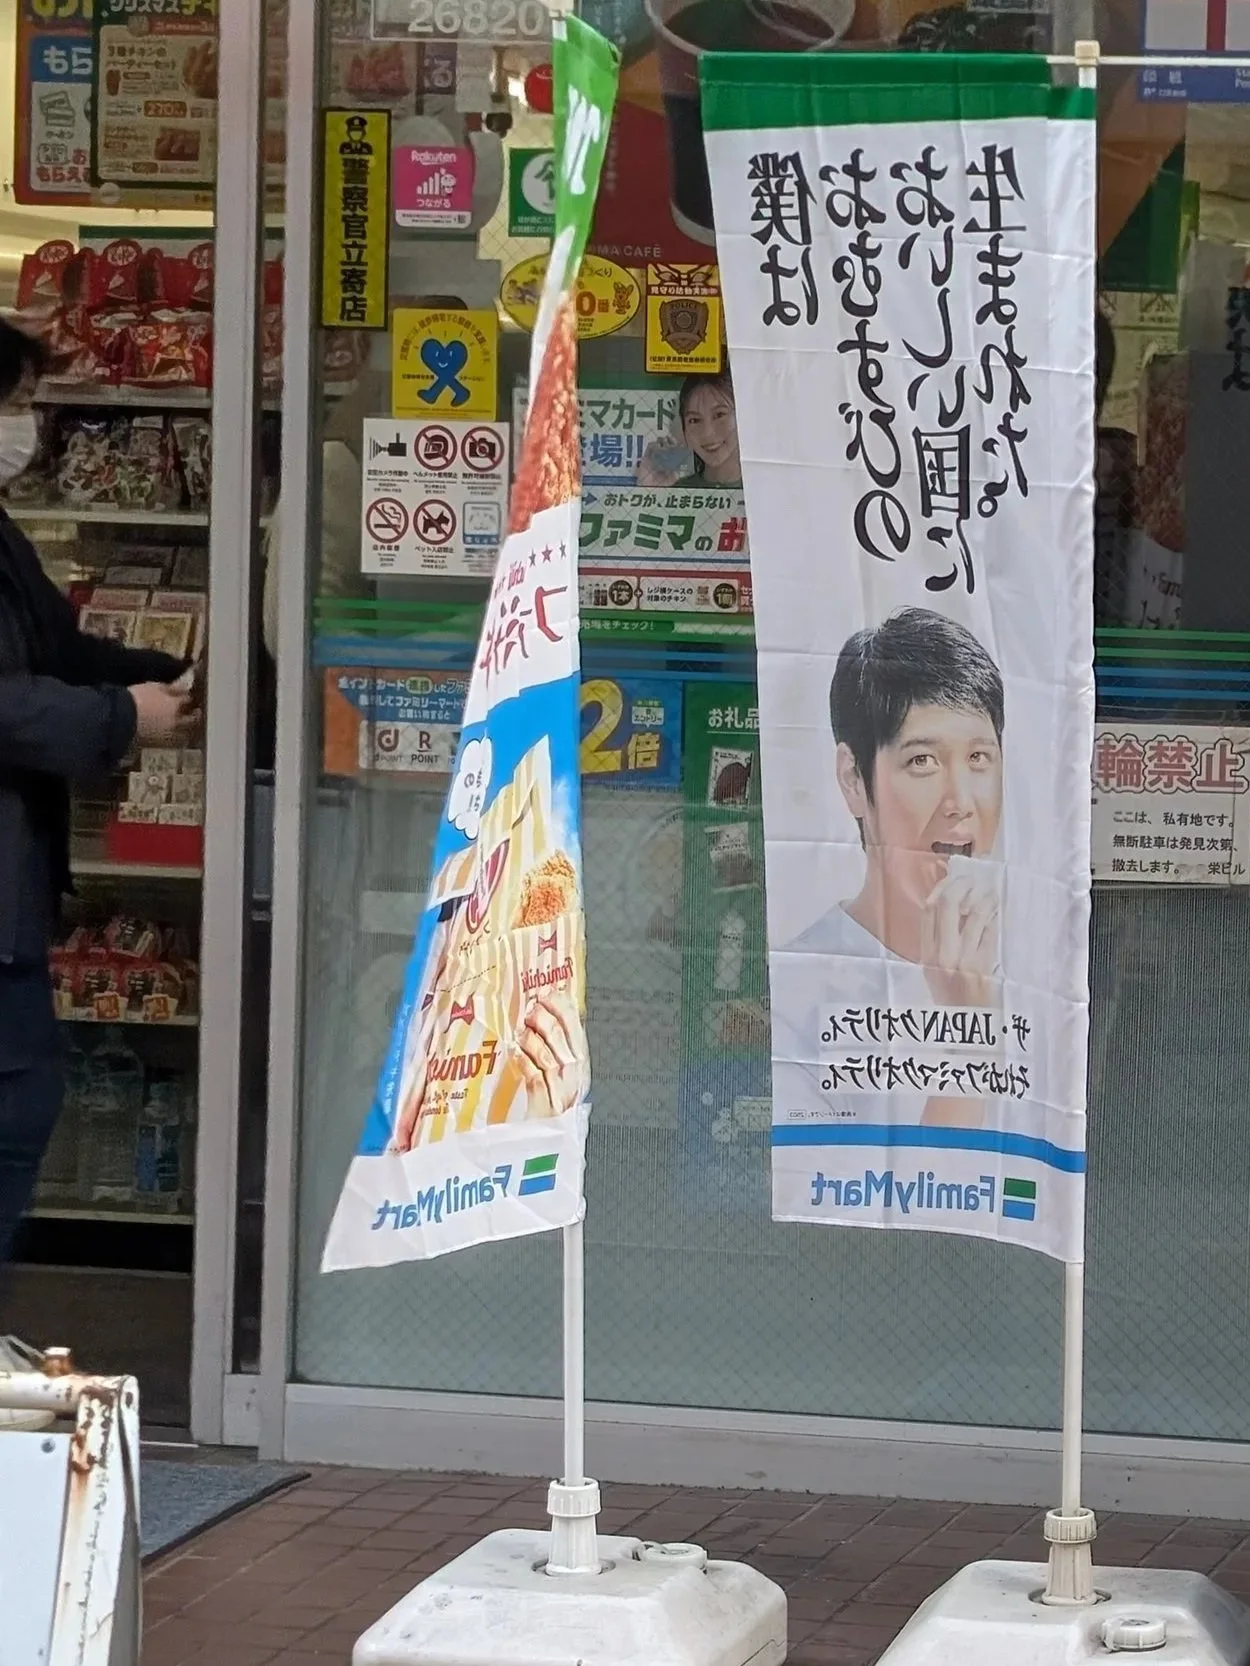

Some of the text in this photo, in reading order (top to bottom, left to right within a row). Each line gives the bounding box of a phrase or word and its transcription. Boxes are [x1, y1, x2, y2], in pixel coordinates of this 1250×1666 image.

[408, 0, 545, 36] 26820
[411, 150, 457, 165] Rakuten
[416, 198, 452, 208] つながる
[339, 156, 371, 323] 警察官立寄店
[604, 493, 731, 510] おトクが、止まらない
[411, 755, 440, 764] POINT
[1112, 834, 1239, 852] 無断駐車は発見次第、
[1112, 859, 1246, 876] 撤去します。 栄ビル
